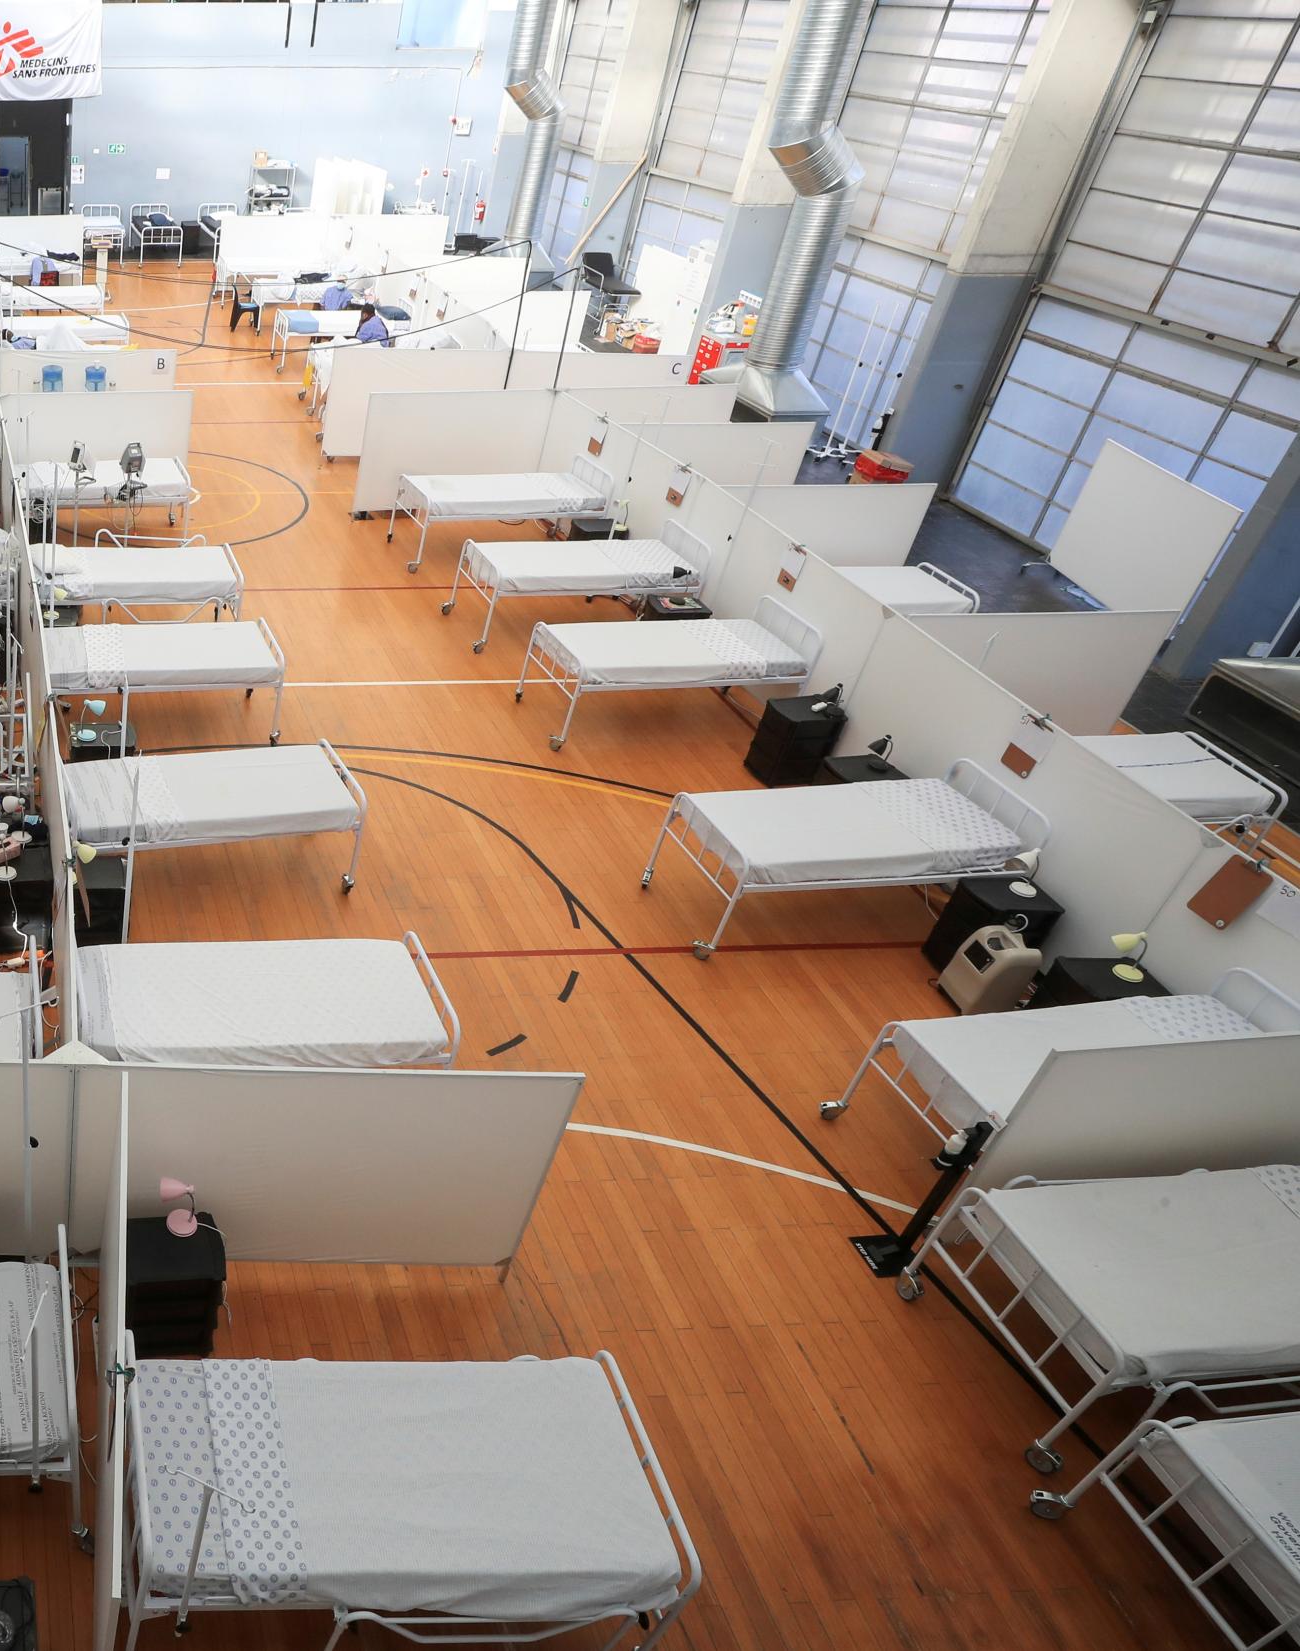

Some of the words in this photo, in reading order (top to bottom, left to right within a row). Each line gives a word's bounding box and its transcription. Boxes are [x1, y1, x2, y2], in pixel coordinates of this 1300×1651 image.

[19, 56, 69, 69] MEDECINS
[12, 69, 37, 79] SANS
[39, 64, 96, 78] FRONTIERES
[157, 357, 166, 370] B
[671, 362, 682, 375] C
[1279, 884, 1296, 898] 50
